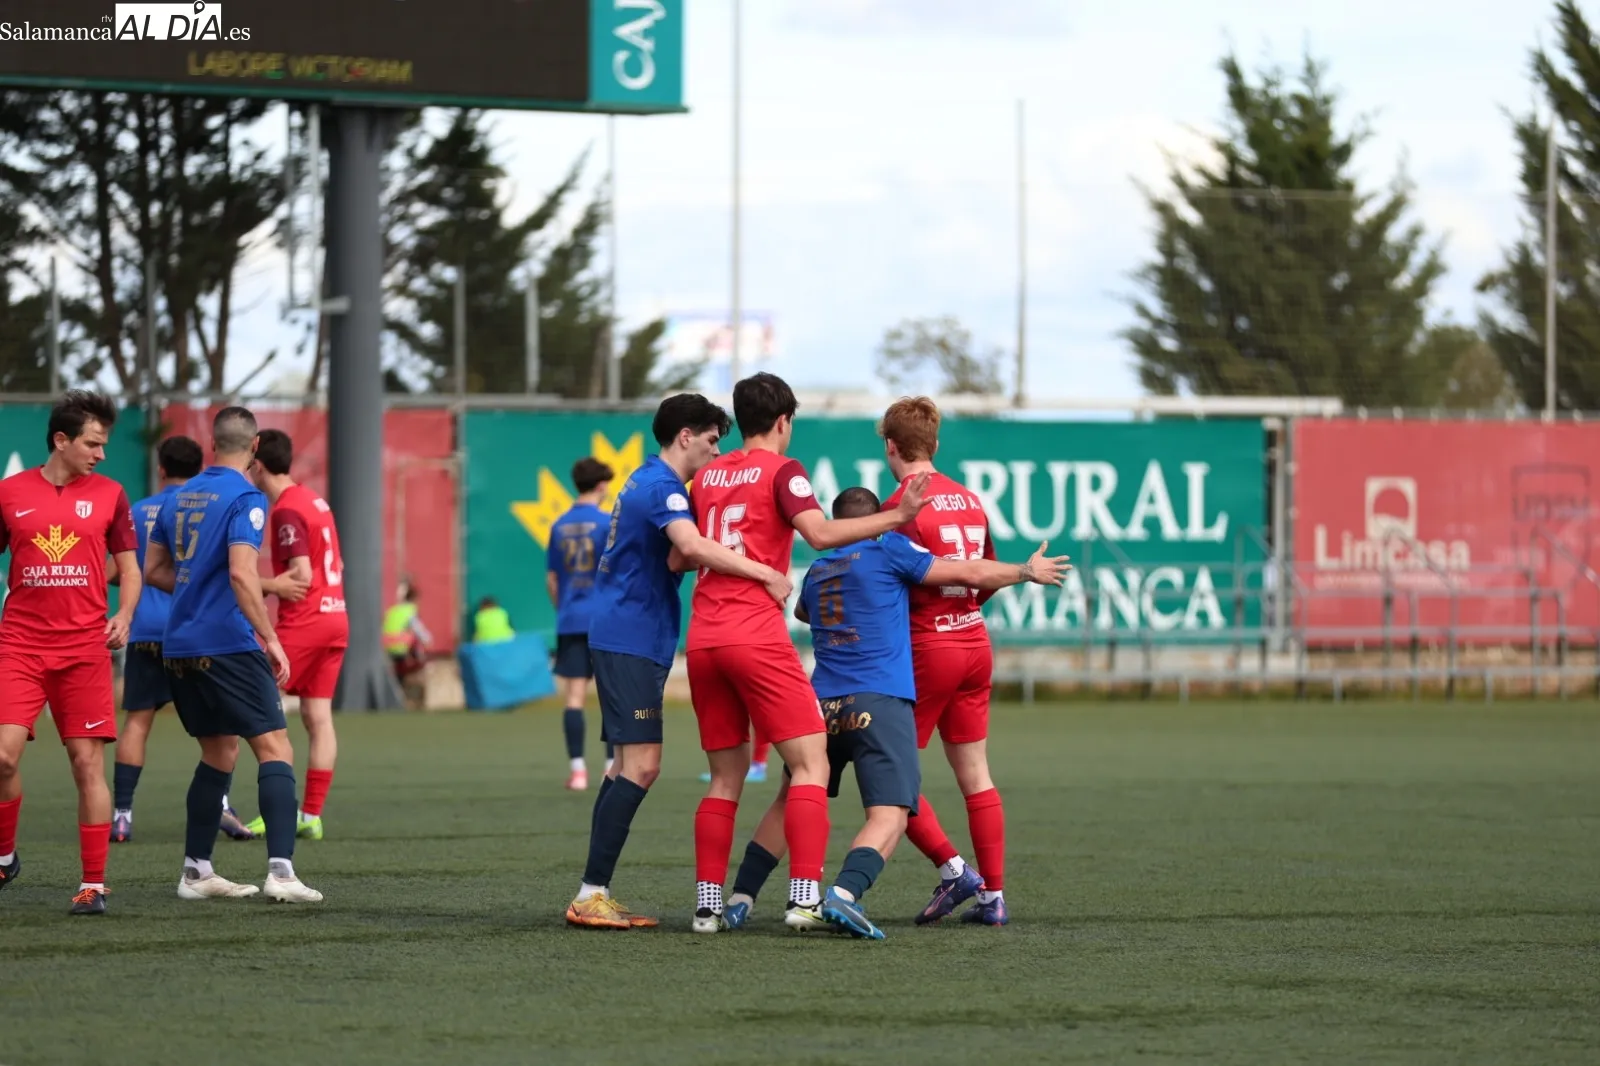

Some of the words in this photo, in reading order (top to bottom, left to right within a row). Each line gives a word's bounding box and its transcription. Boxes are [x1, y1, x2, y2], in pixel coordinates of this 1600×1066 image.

[611, 0, 667, 91] CAJ
[702, 466, 762, 489] QUIJANO
[959, 459, 1229, 542] RURAL
[23, 565, 49, 580] CAJA
[51, 565, 89, 577] RURAL
[34, 577, 89, 587] SALAMANCA
